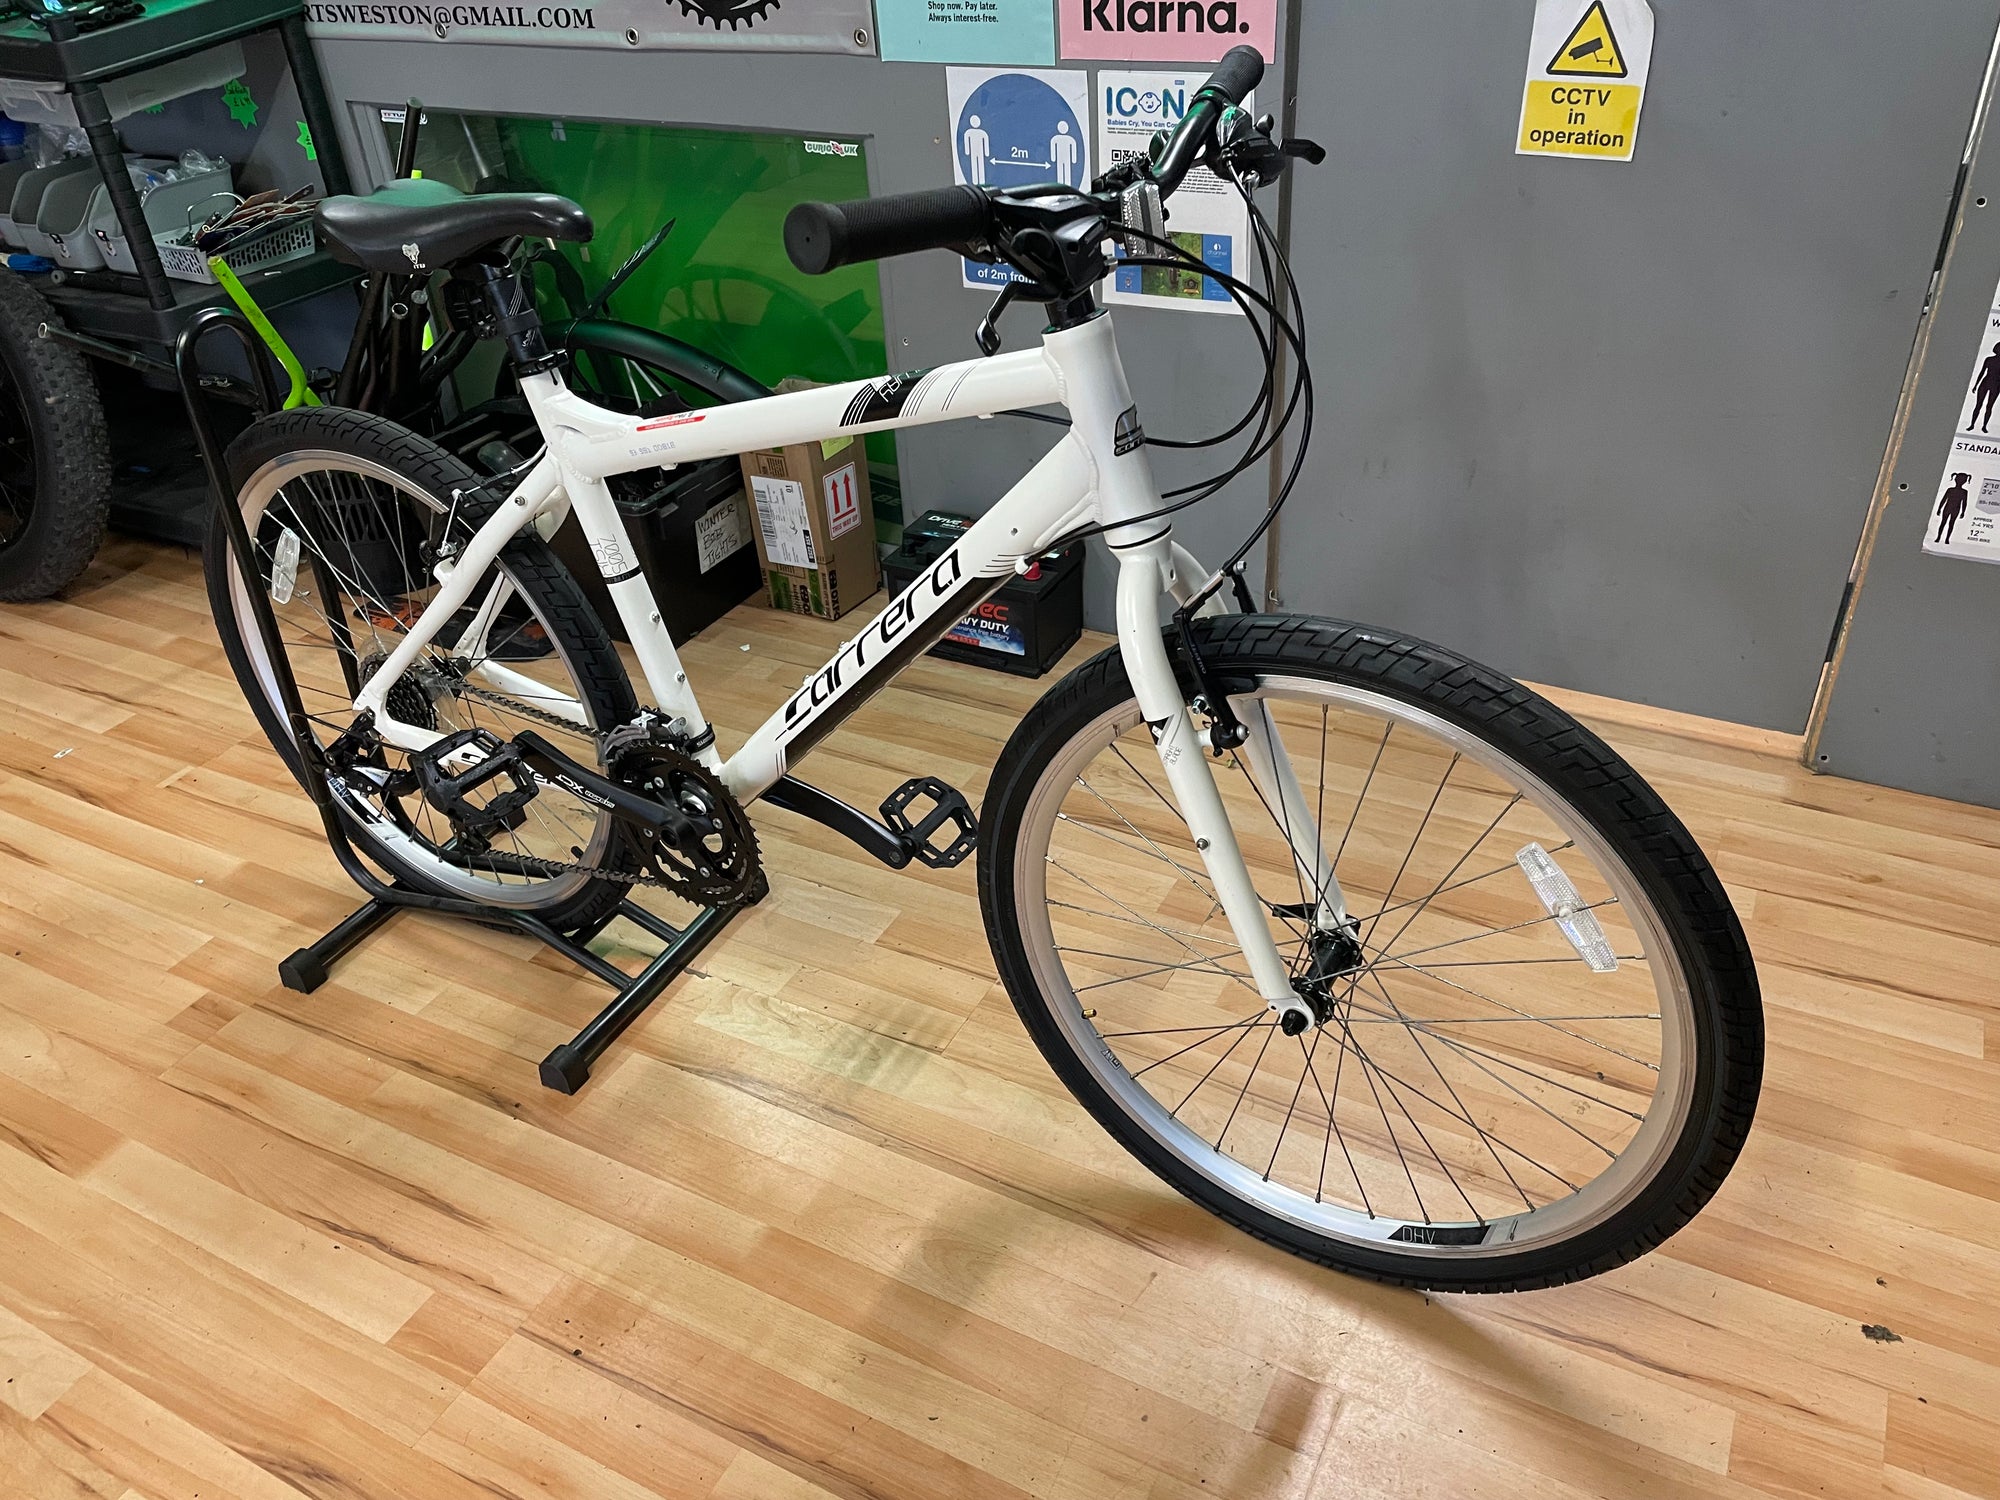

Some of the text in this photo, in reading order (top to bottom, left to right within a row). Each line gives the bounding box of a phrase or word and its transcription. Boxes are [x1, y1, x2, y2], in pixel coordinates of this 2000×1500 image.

[928, 1, 998, 12] Shop now. Pay later.
[928, 13, 999, 23] Always interest-free.
[1551, 87, 1612, 107] CCTV
[1128, 119, 1140, 128] Cry,
[1567, 108, 1586, 125] in
[1529, 129, 1625, 148] operation
[1011, 146, 1030, 160] 2m
[977, 268, 988, 279] of
[991, 268, 1007, 280] 2m
[1955, 442, 2000, 455] STANDA
[697, 503, 735, 535] WINTER
[831, 514, 858, 534] THIS WAY UP
[600, 533, 628, 575] 7005
[703, 534, 738, 567] TIGHTS
[980, 619, 1010, 634] DUTY
[989, 631, 1010, 642] battery
[776, 549, 961, 741] carrera
